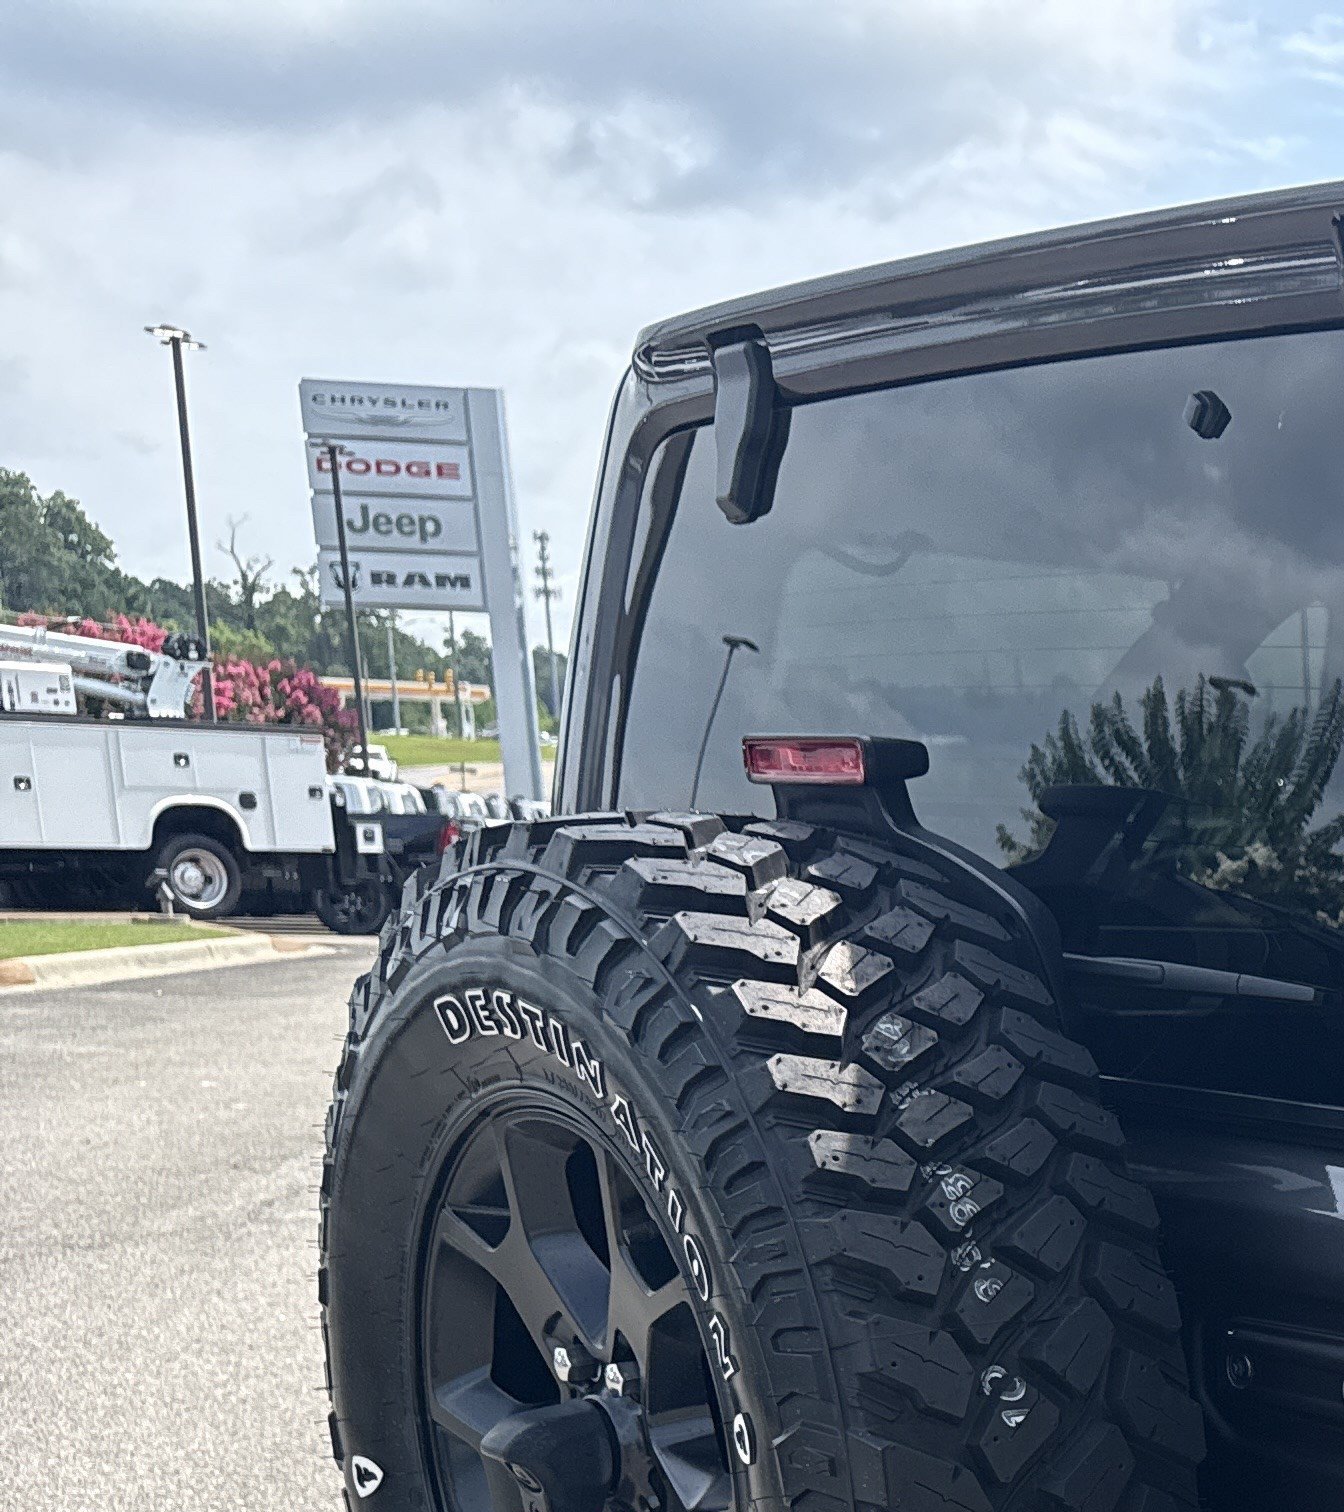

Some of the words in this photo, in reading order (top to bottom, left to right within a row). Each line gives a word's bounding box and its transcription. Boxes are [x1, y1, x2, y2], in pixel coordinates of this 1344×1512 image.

[312, 393, 449, 411] CHRYSLER
[316, 457, 461, 481] DODGE
[346, 503, 443, 544] Jeep
[370, 570, 471, 591] RAM
[434, 990, 740, 1382] DESTINATION
